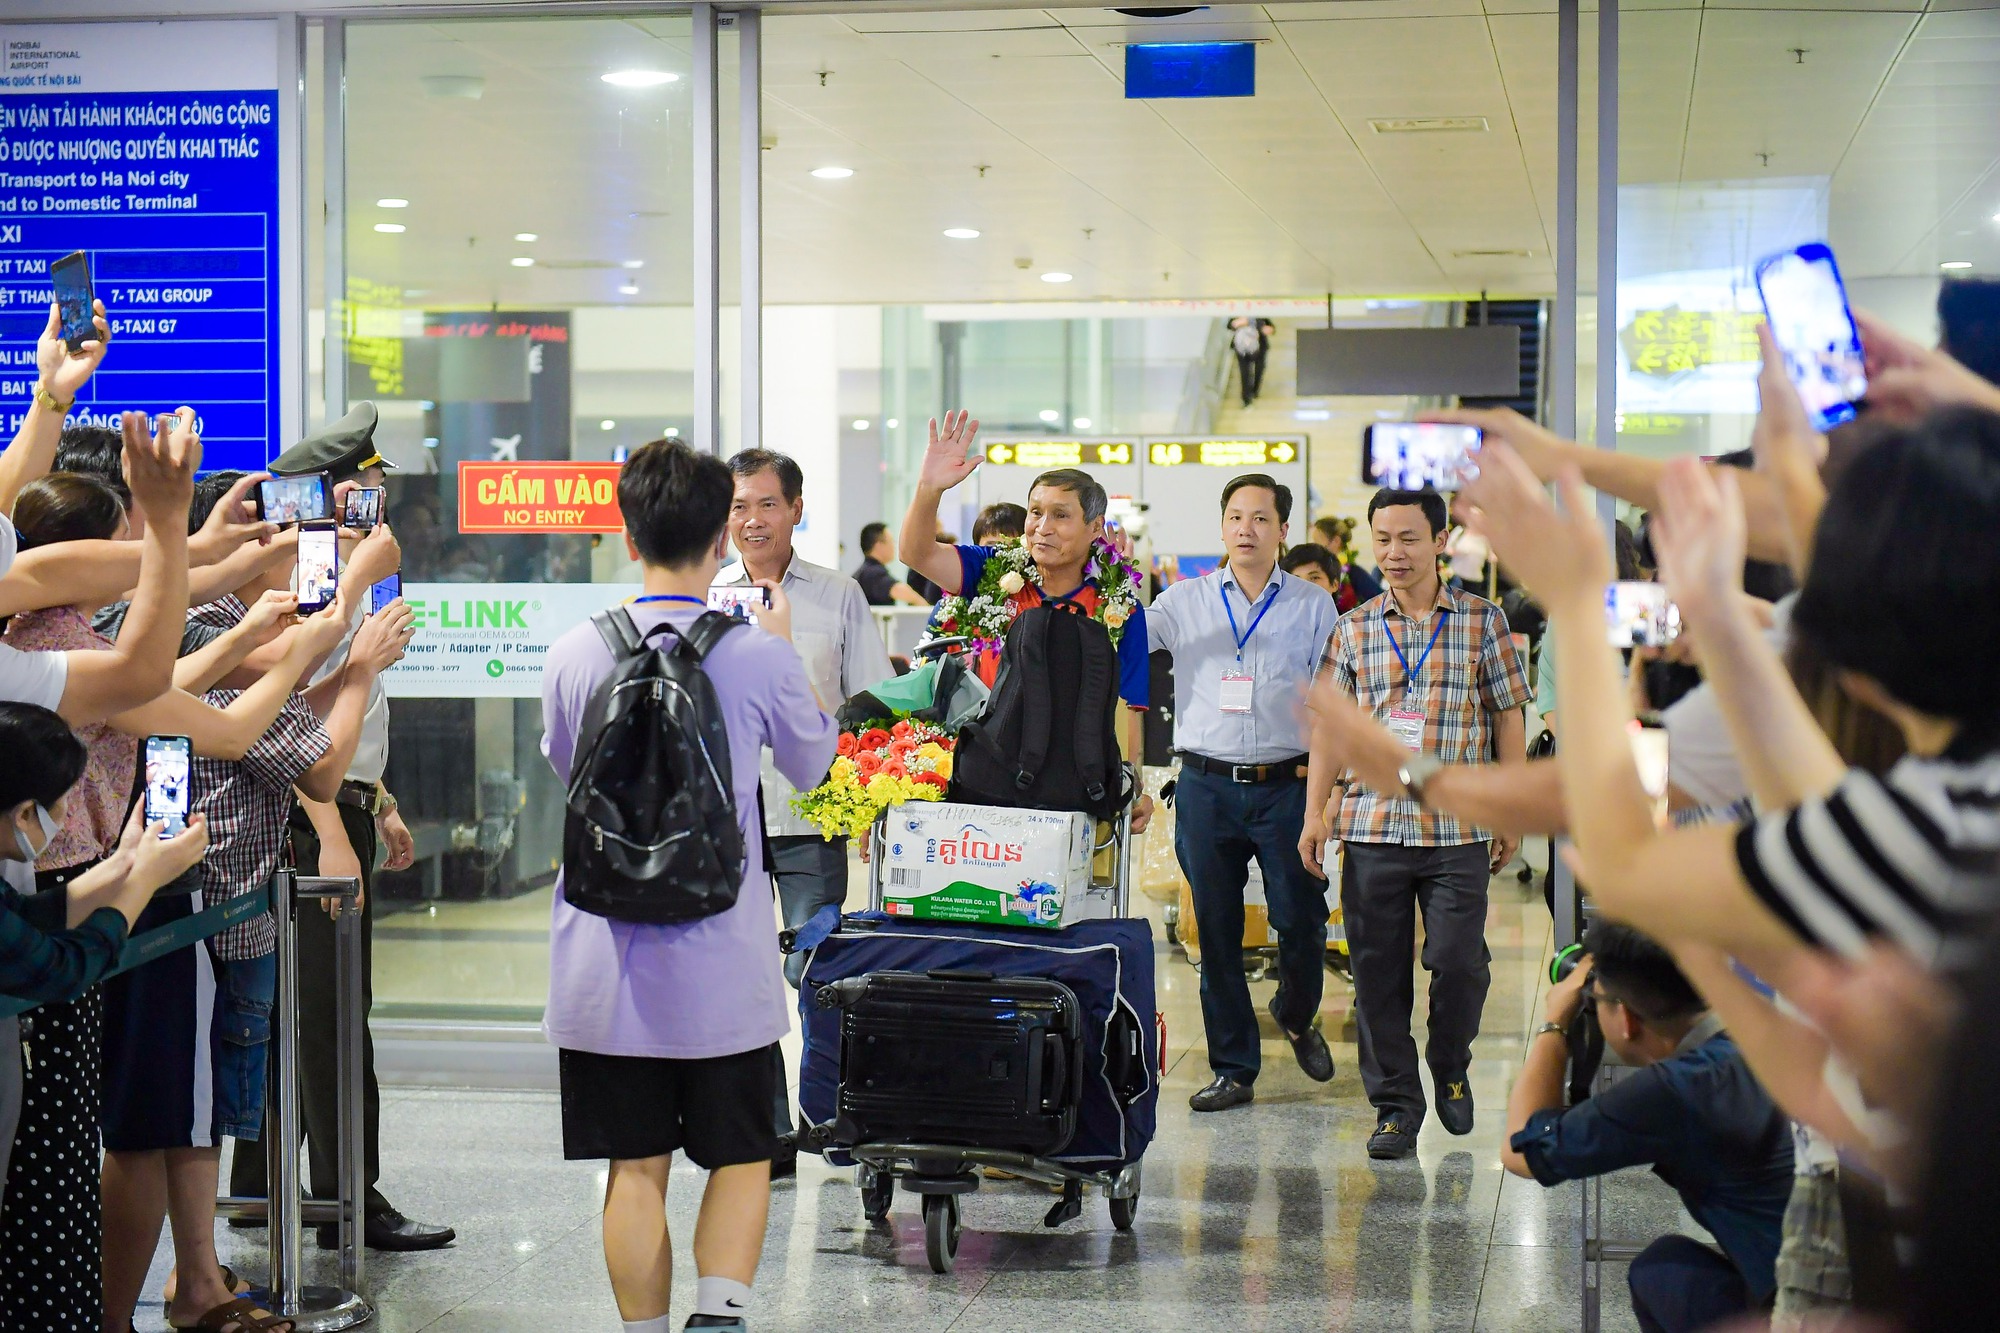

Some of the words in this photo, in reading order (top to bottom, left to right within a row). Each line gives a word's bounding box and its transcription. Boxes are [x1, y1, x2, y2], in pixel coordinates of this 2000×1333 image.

[10, 51, 81, 59] INTERNATIONAL
[10, 61, 49, 69] AIRPORT
[19, 103, 49, 132] VẬN
[52, 100, 76, 127] TẢI
[80, 100, 121, 127] HÀNH
[125, 101, 176, 126] KHÁCH
[180, 100, 223, 125] CÔNG
[227, 99, 270, 130] CỘNG
[12, 139, 54, 166] ĐƯỢC
[58, 138, 122, 165] NHƯỢNG
[180, 138, 215, 159] KHAI
[218, 133, 259, 158] THÁC
[0, 172, 77, 191] Transport
[80, 172, 97, 187] to
[101, 171, 123, 186] Ha
[128, 170, 155, 186] Noi
[159, 170, 189, 189] city
[21, 197, 38, 211] to
[43, 195, 121, 211] Domestic
[125, 193, 197, 210] Terminal
[0, 225, 21, 243] XI
[15, 259, 46, 274] TAXI
[111, 289, 124, 303] 7-
[127, 288, 159, 303] TAXI
[162, 288, 213, 303] GROUP
[111, 319, 155, 334] 8-TAXI
[158, 319, 177, 334] G7
[2, 381, 25, 396] BAI
[478, 470, 545, 505] CẤM
[554, 474, 613, 505] VÀO
[504, 510, 531, 524] NO
[536, 510, 585, 524] ENTRY
[426, 631, 477, 639] Professional
[449, 643, 491, 654] Adapter
[503, 643, 512, 653] IP
[515, 643, 551, 654] Camer
[927, 838, 936, 863] eau
